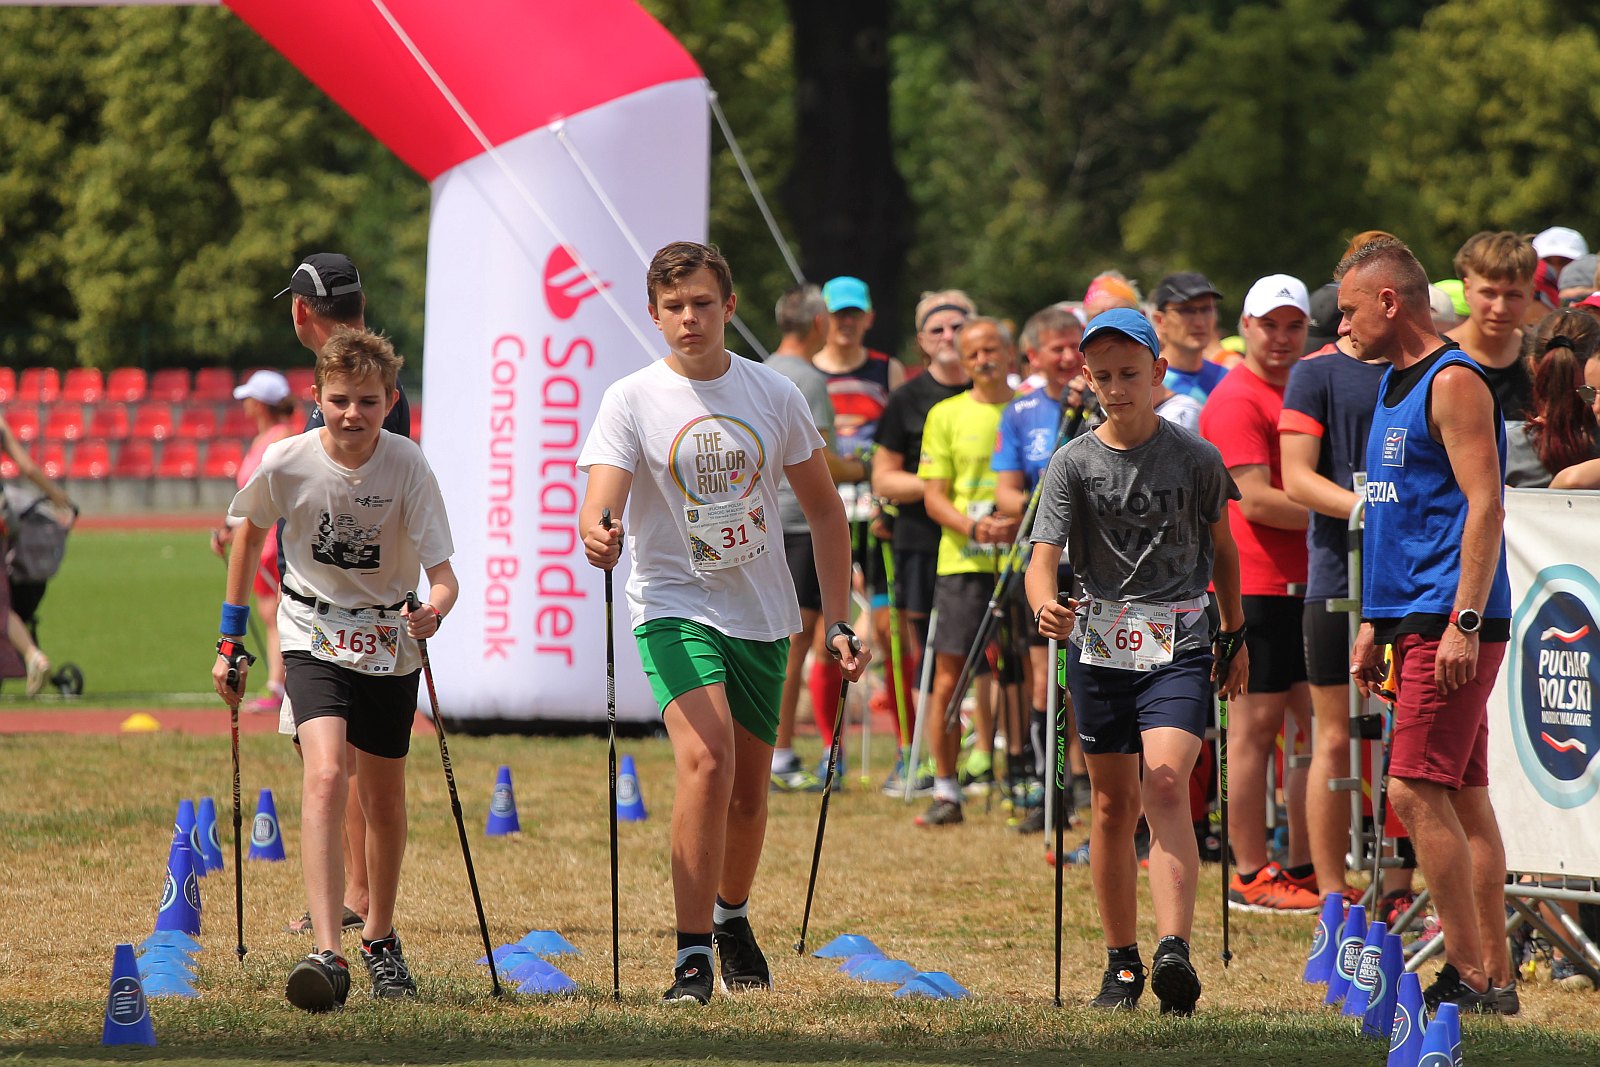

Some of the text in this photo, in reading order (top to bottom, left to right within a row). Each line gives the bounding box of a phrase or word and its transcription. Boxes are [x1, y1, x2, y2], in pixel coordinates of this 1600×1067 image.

[693, 432, 723, 453] THE
[695, 450, 746, 474] COLOR
[484, 334, 525, 660] Consumer Bank
[697, 473, 728, 495] RUN
[535, 336, 594, 667] Santander
[1097, 487, 1184, 516] MOTI
[721, 524, 749, 549] 31
[335, 629, 378, 655] 163
[1115, 628, 1143, 652] 69
[1538, 649, 1591, 678] PUCHAR
[1538, 677, 1592, 711] POLSKI
[1560, 712, 1592, 727] WALKING
[1057, 736, 1065, 774] FIZAN
